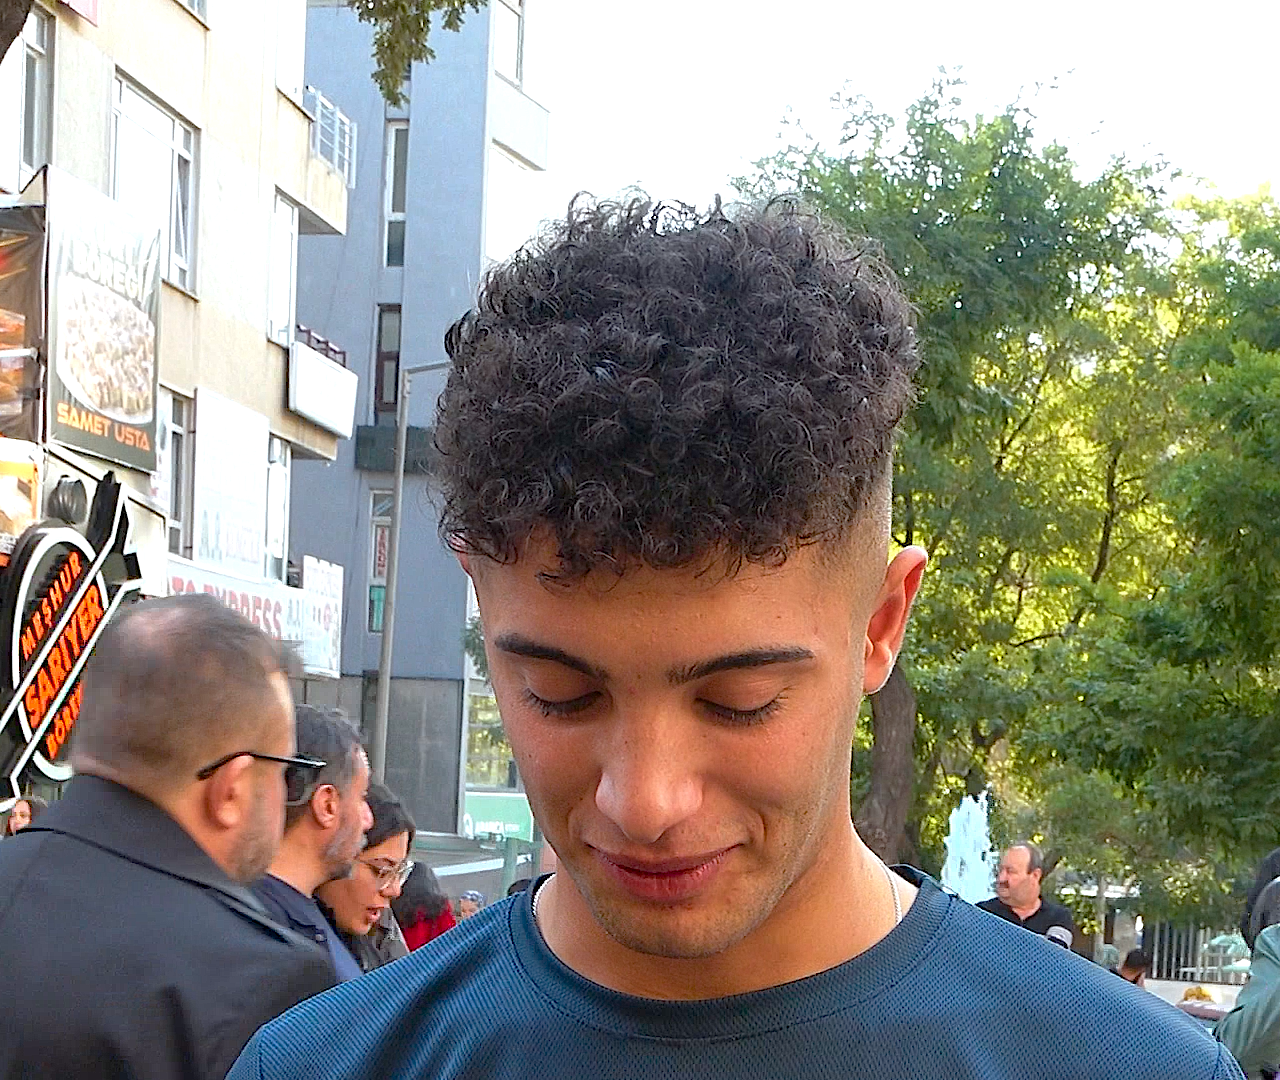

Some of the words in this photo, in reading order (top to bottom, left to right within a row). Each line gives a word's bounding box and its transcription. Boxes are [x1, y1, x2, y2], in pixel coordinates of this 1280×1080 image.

[56, 401, 110, 438] SAMET
[113, 422, 151, 452] USTA
[21, 551, 82, 661] MEŞHUR
[25, 584, 105, 729] SARIYER
